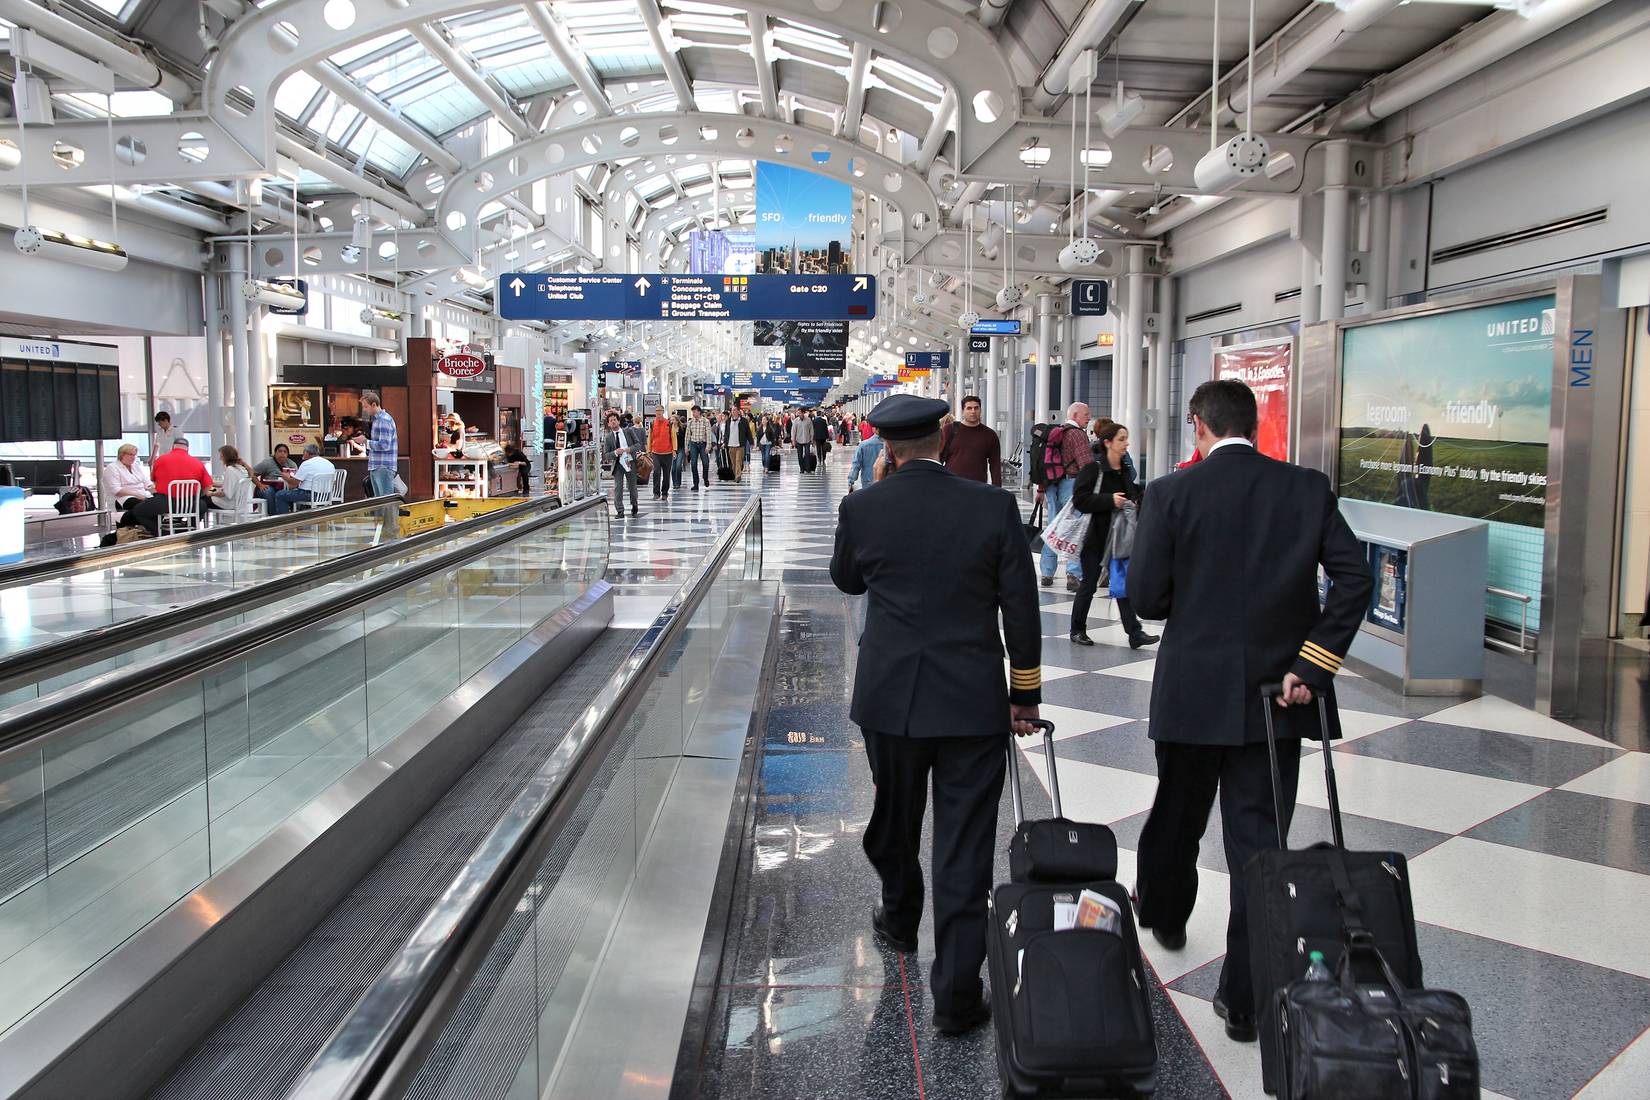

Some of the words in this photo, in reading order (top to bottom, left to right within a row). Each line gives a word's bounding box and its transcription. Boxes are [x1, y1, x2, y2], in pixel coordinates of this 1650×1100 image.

[761, 213, 781, 222] SFO
[808, 212, 847, 224] friendly
[547, 276, 577, 284] Customer
[578, 276, 601, 284] Service
[602, 276, 623, 284] Center
[548, 284, 582, 292] Telephones
[790, 285, 809, 293] Gate
[811, 285, 828, 293] C20
[547, 292, 567, 300] United
[569, 292, 584, 300] Club
[671, 301, 701, 309] Baggage
[703, 301, 722, 309] Claim
[671, 309, 696, 317] Ground
[698, 309, 730, 317] Transport
[1487, 317, 1538, 337] UNITED
[19, 345, 51, 355] UNITED
[444, 357, 480, 368] Brioche
[1570, 329, 1593, 387] MEN
[1367, 402, 1407, 425] legroom
[1446, 400, 1498, 429] friendly
[1419, 464, 1443, 477] Economy
[1459, 467, 1479, 481] today.
[1480, 468, 1490, 483] fly
[1490, 469, 1501, 482] the
[1501, 470, 1528, 486] friendly
[1528, 473, 1547, 486] skies
